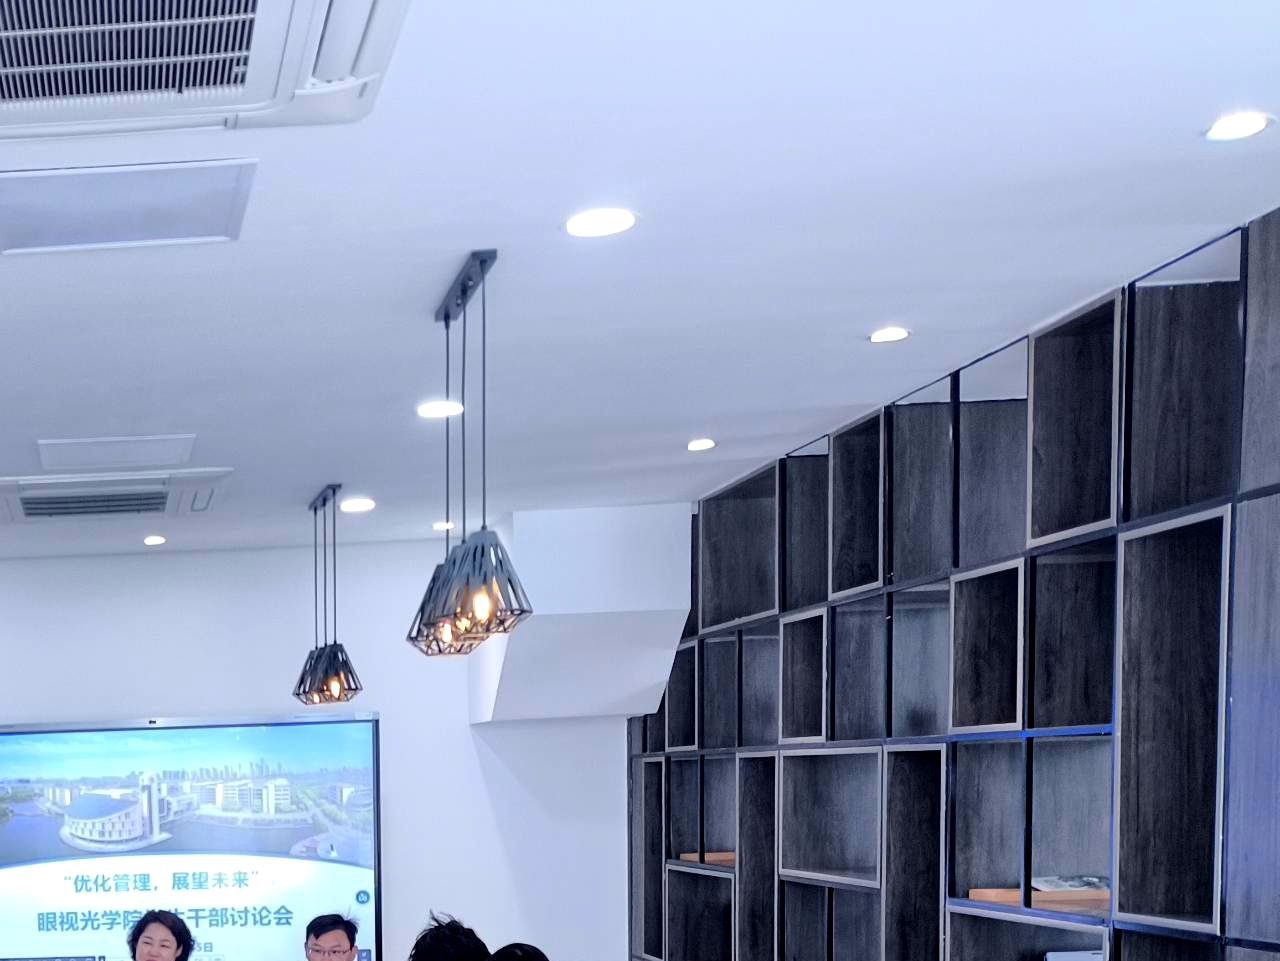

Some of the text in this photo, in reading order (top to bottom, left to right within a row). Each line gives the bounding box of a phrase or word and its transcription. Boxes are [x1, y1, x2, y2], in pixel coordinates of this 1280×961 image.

[37, 905, 294, 932] 眼视光学院干部讨论会
